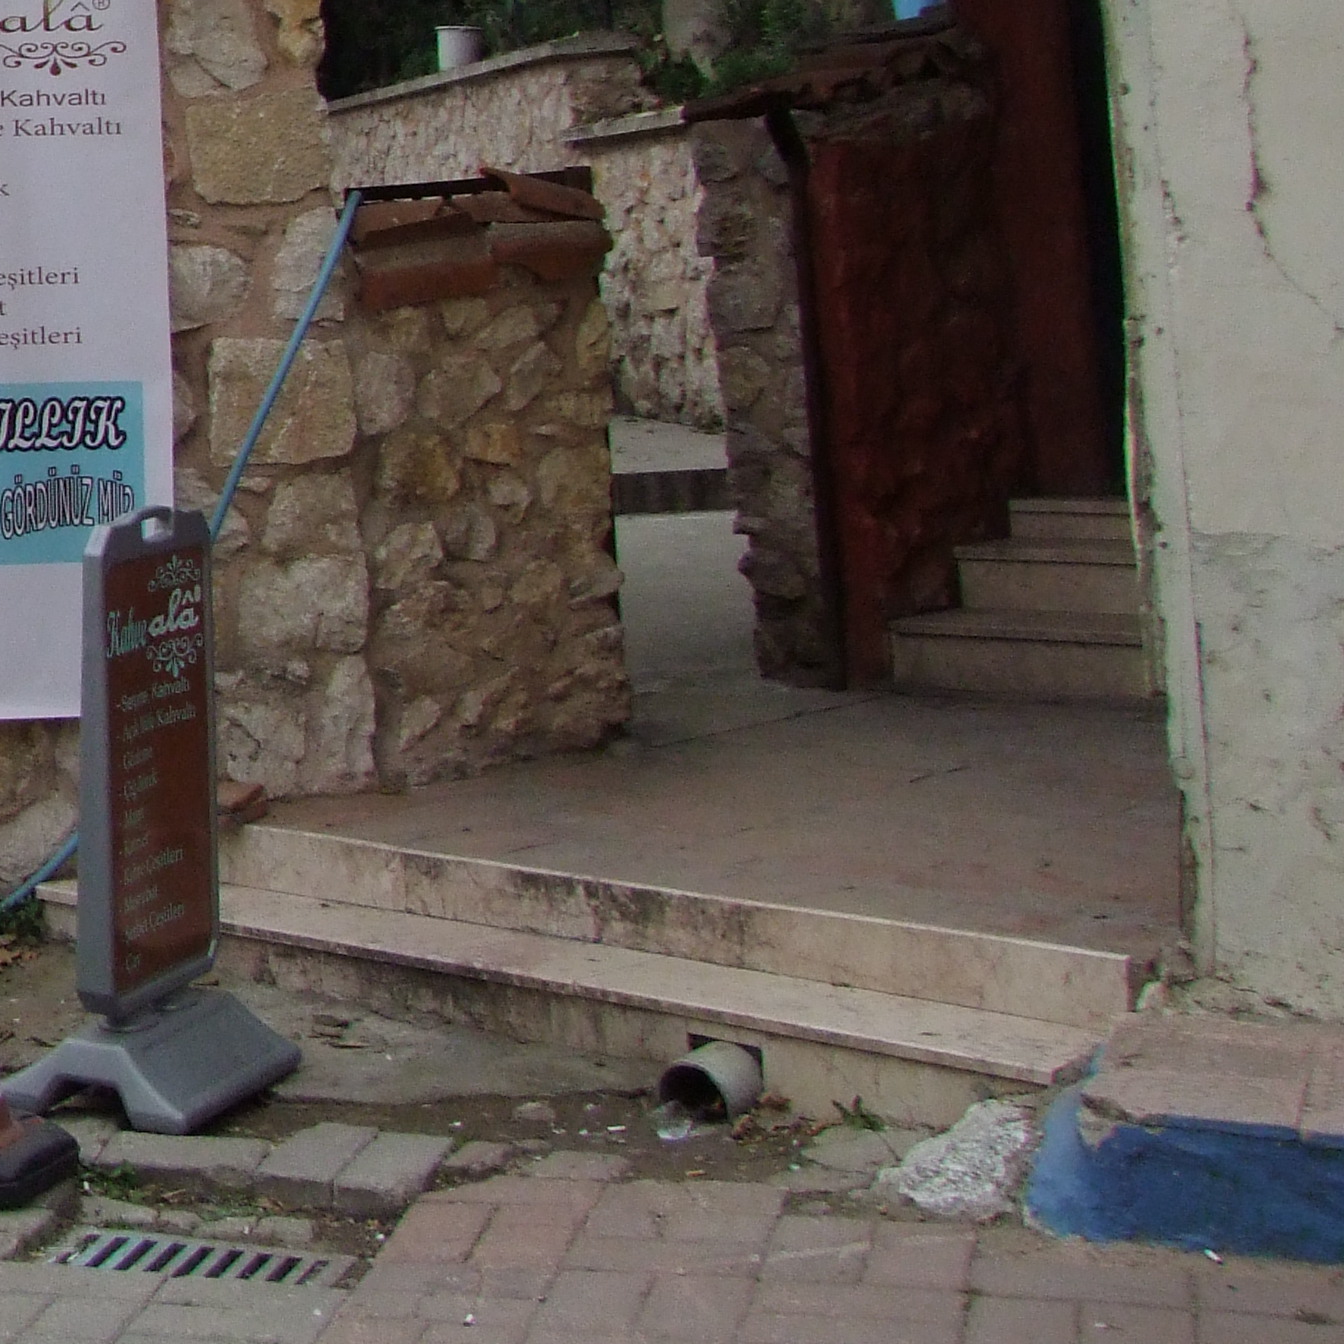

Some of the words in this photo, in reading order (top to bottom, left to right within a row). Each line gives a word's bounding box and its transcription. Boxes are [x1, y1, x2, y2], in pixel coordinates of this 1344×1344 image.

[0, 88, 107, 108] Kahvaltı
[12, 116, 122, 137] Kahvaltı
[0, 465, 95, 539] GÖRDÜNÜZ
